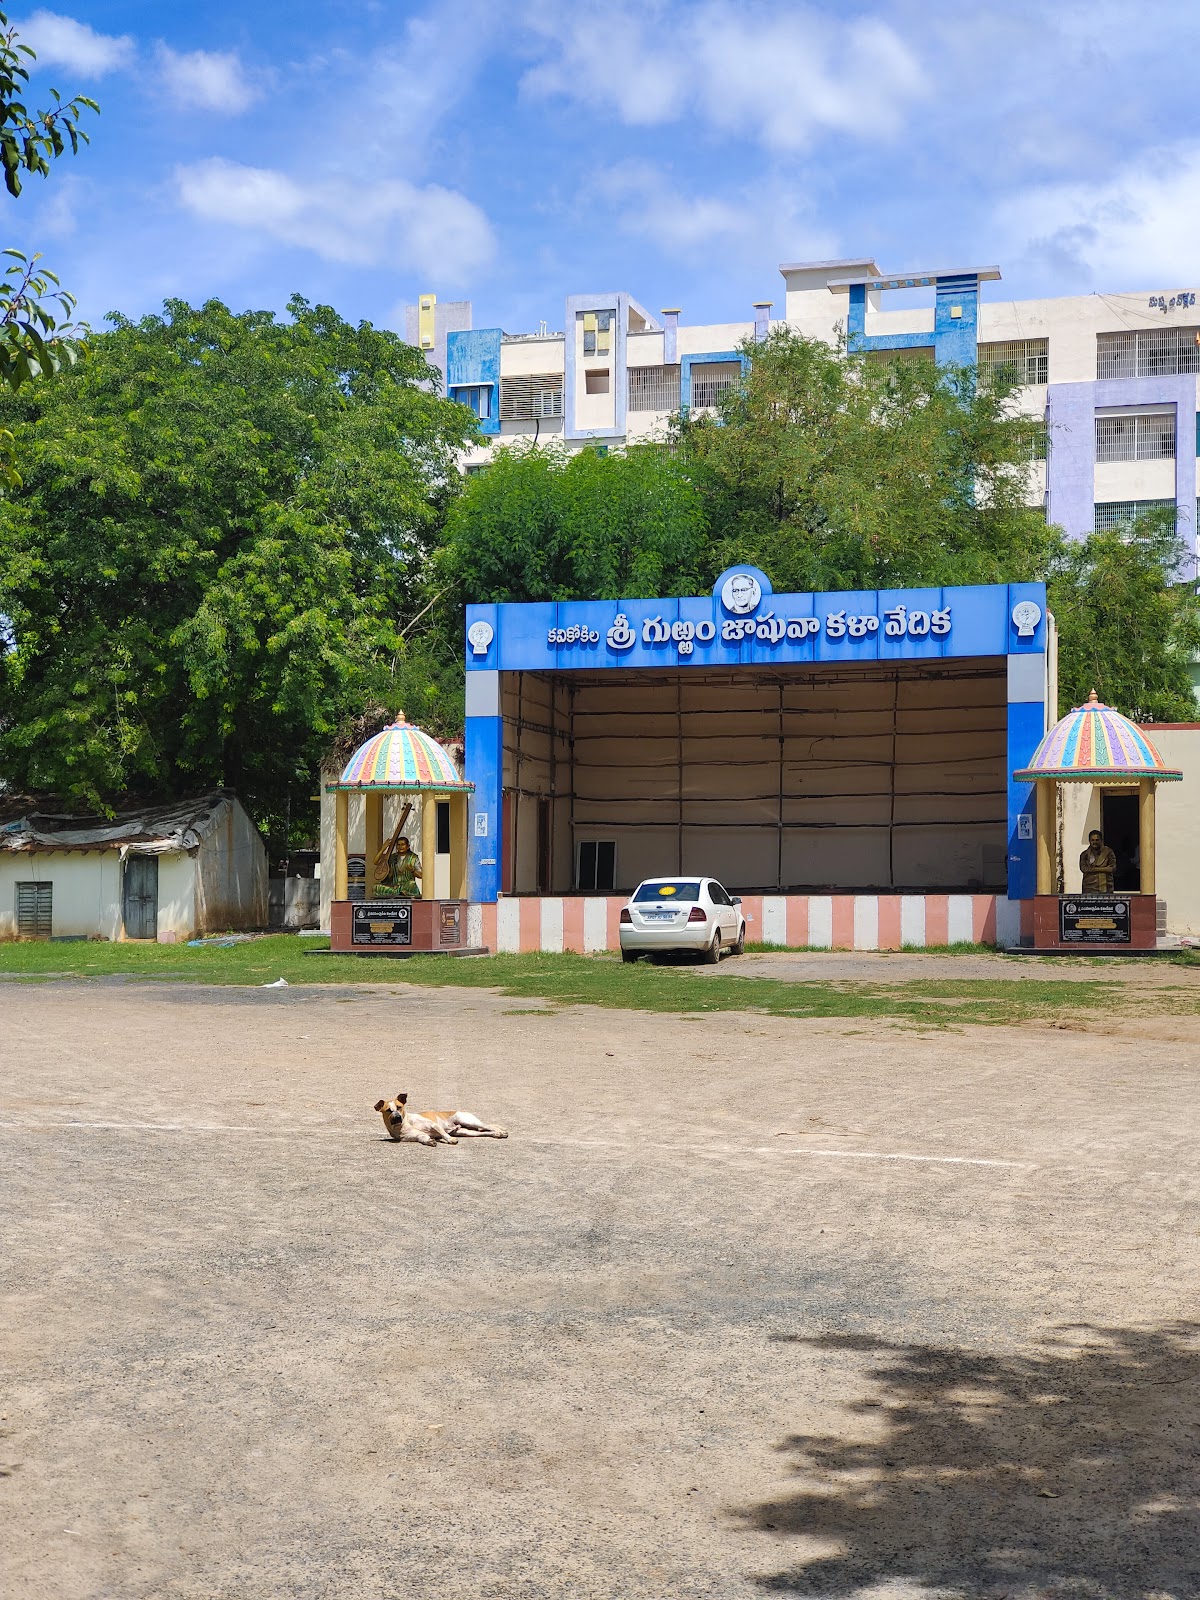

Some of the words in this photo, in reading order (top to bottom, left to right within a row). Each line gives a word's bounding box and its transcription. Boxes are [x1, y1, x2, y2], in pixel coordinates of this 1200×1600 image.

[547, 623, 600, 644] కవికోకిల
[606, 613, 636, 649] శ్రీ
[721, 610, 821, 644] జాషువా
[826, 609, 880, 638] కళా
[884, 604, 952, 636] వేదిక
